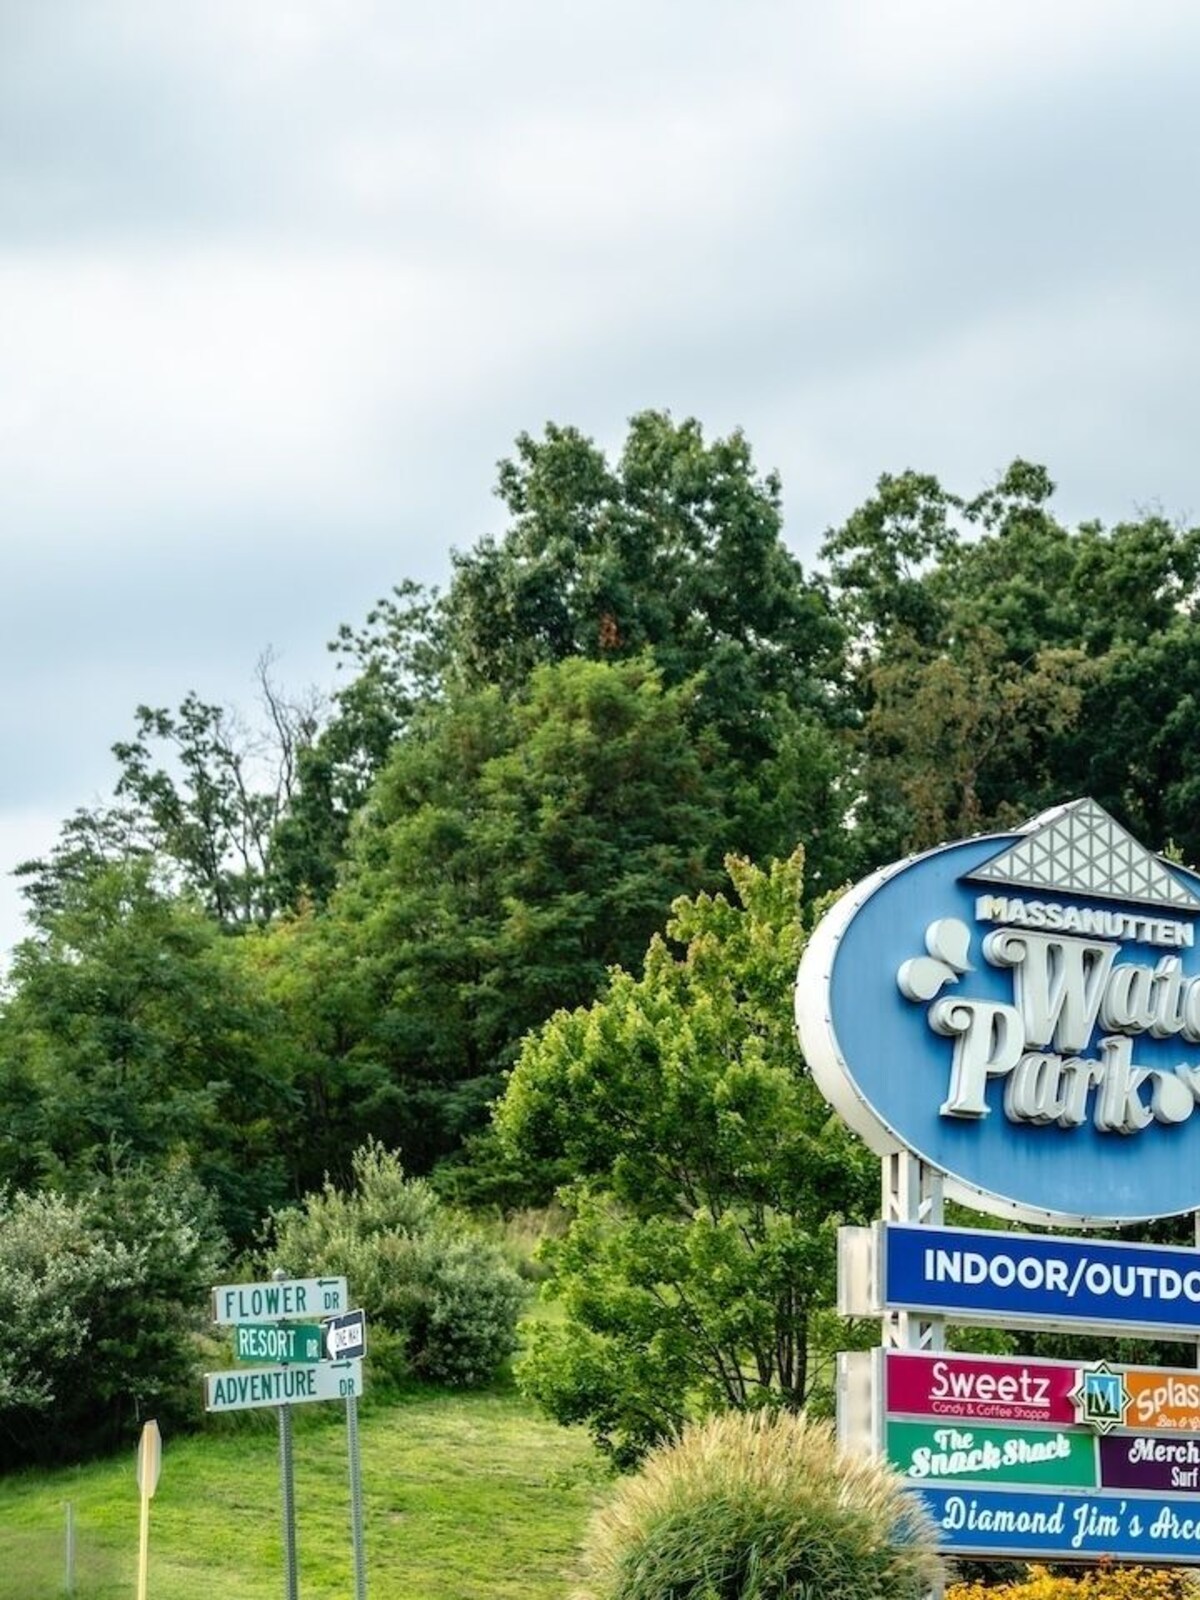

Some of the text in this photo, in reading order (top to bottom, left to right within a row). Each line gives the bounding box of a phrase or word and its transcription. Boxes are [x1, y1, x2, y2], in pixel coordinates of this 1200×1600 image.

[975, 894, 1194, 947] MASSANUTTEN
[928, 996, 1154, 1134] Park
[225, 1286, 340, 1318] FLOWER DR
[238, 1328, 319, 1358] RESORT DR
[335, 1329, 346, 1349] ONE
[213, 1369, 355, 1406] ADVENTURE DR
[931, 1361, 1050, 1402] Sweetz
[1089, 1380, 1118, 1415] M
[931, 1401, 1050, 1420] Candy & Coffee Shoppe
[1157, 1414, 1177, 1428] Bar
[908, 1433, 1071, 1478] Snack Shack
[934, 1429, 974, 1450] The
[1171, 1466, 1200, 1487] Surf
[942, 1496, 1064, 1534] Diamond
[1072, 1502, 1143, 1548] Jim's
